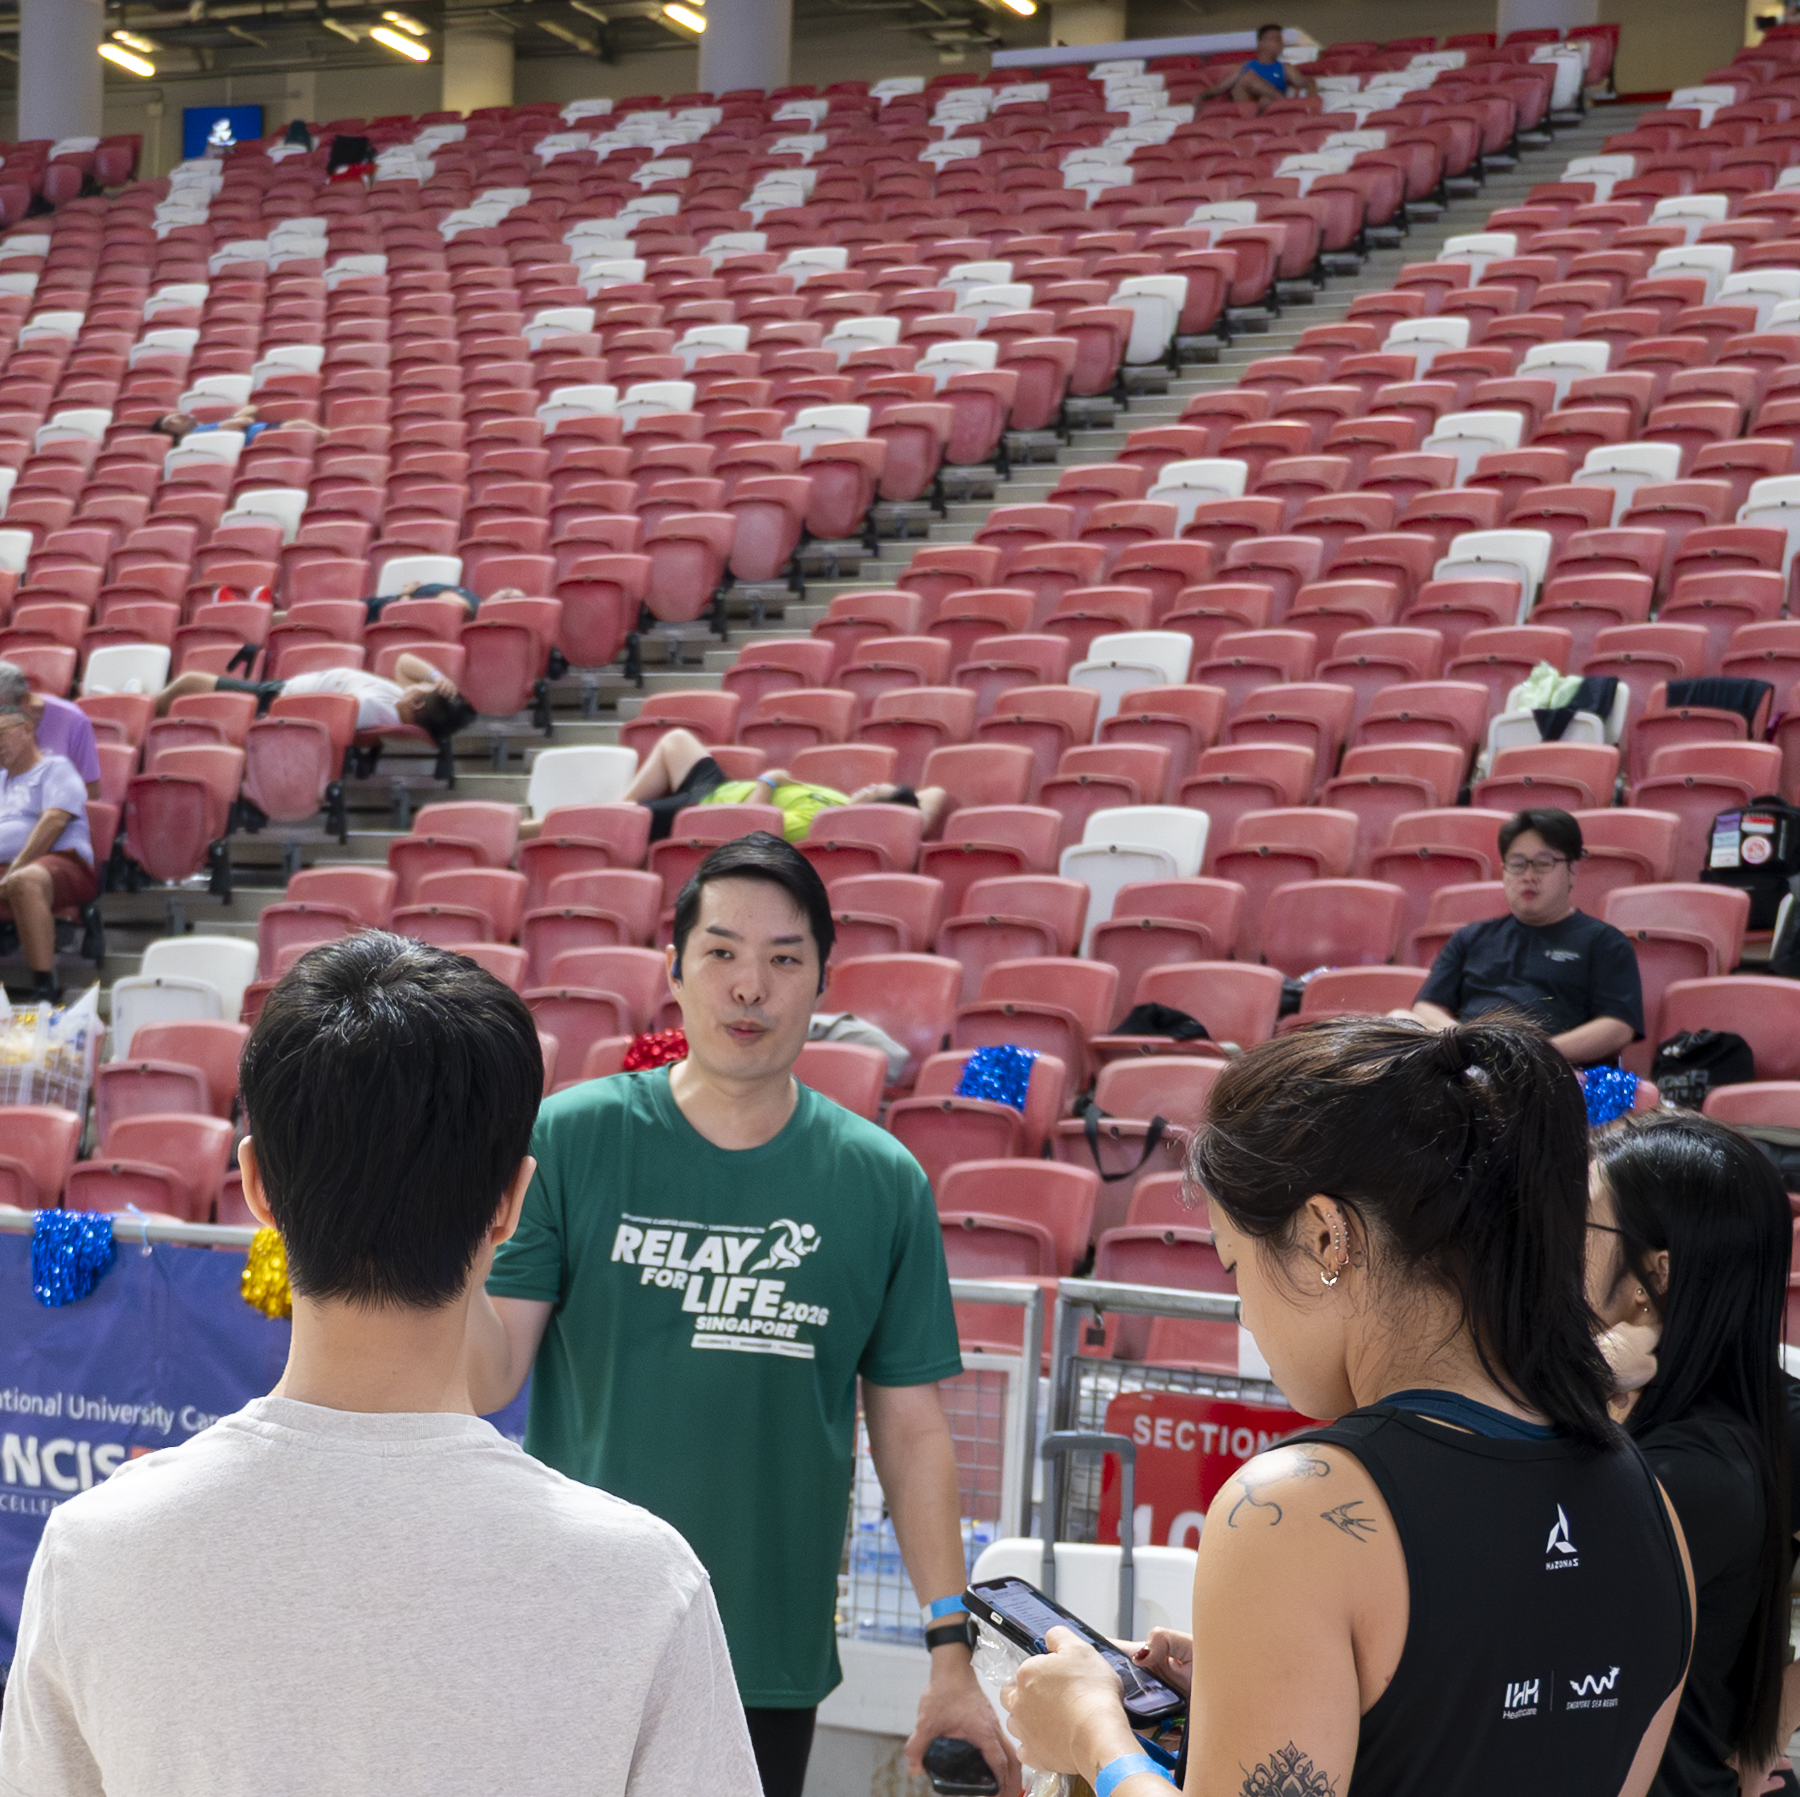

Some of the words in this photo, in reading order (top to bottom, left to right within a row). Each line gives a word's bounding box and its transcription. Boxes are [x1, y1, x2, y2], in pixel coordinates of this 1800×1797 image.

[611, 1223, 762, 1275] RELAY
[640, 1267, 689, 1291] FOR
[681, 1274, 787, 1319] LIFE
[695, 1314, 799, 1339] SINGAPORE
[68, 1395, 175, 1436] University
[1132, 1414, 1278, 1457] SECTION
[1502, 1707, 1538, 1719] Healthcare
